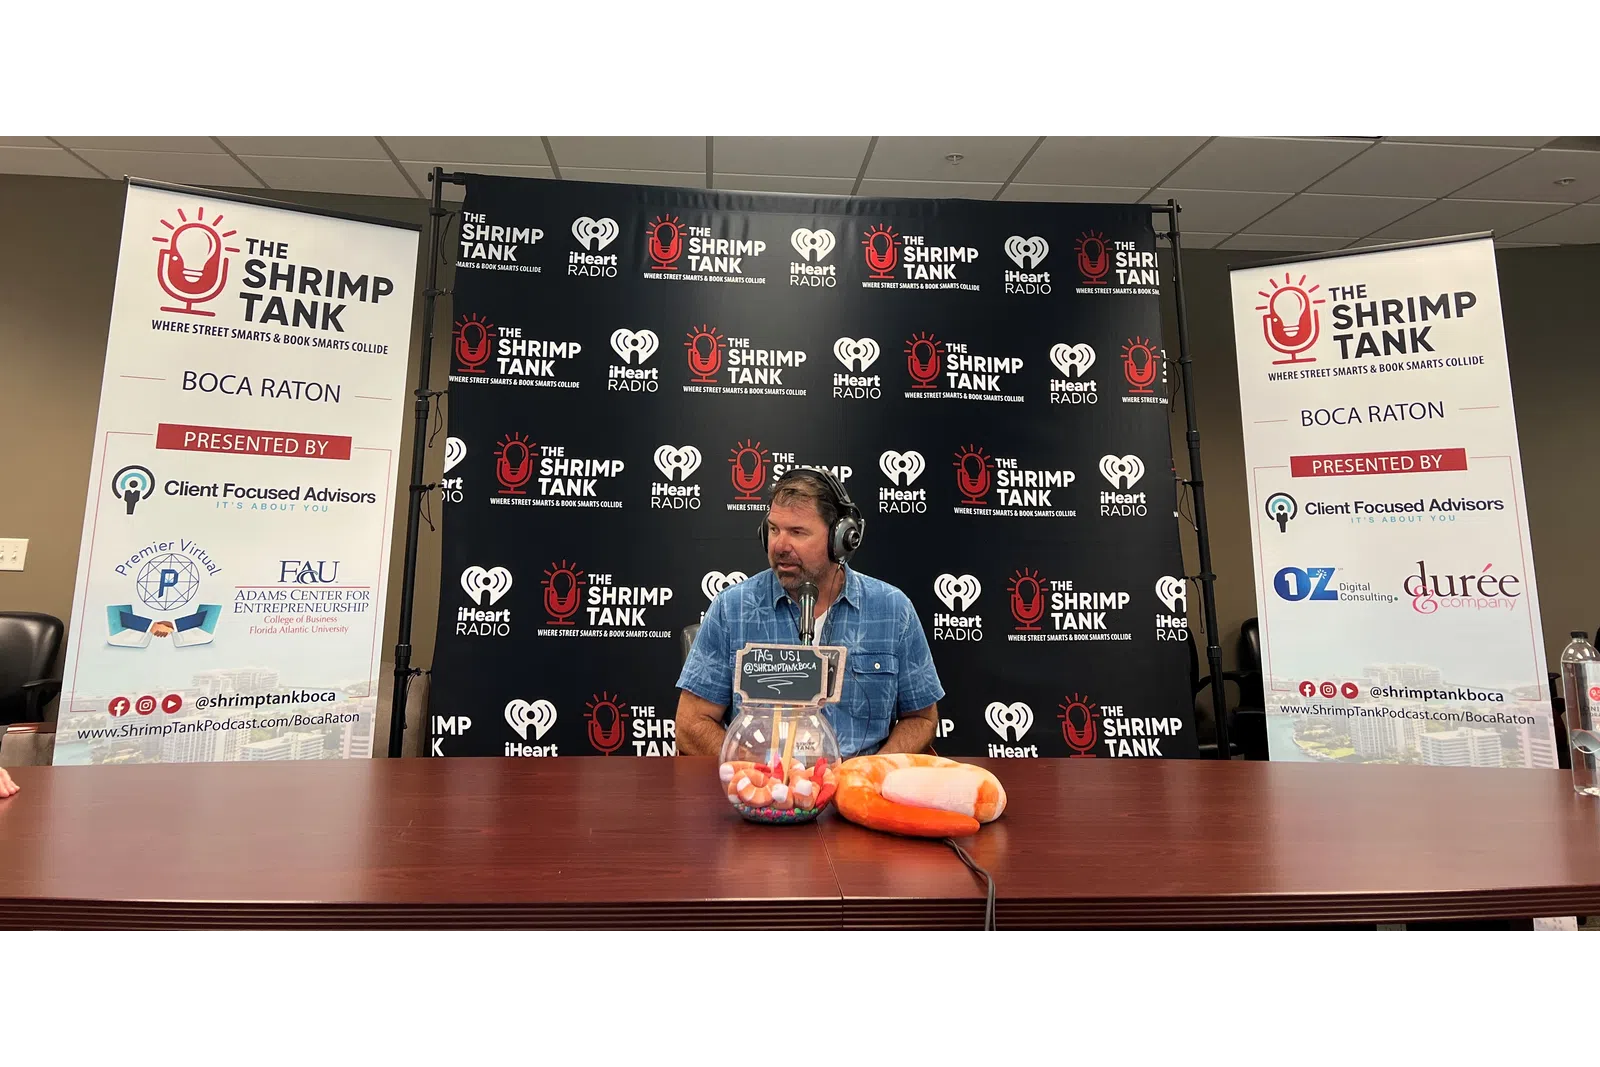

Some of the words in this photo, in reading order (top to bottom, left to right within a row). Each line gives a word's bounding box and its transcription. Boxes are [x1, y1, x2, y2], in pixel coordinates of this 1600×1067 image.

[463, 212, 486, 223] THE
[461, 224, 544, 245] SHRIMP
[689, 226, 711, 237] THE
[245, 238, 288, 259] THE
[689, 237, 766, 256] SHRIMP
[902, 236, 924, 246] THE
[460, 241, 517, 261] TANK
[569, 251, 617, 266] iHeart
[903, 246, 979, 263] SHRIMP
[567, 264, 618, 278] RADIO
[688, 255, 742, 274] TANK
[790, 262, 836, 276] iHeart
[903, 263, 957, 280] TANK
[242, 259, 394, 304] SHRIMP
[790, 274, 836, 288] RADIO
[1005, 270, 1050, 283] iHeart
[1005, 282, 1051, 295] RADIO
[1329, 284, 1367, 302] THE
[239, 292, 347, 332] TANK
[1332, 291, 1477, 330] SHRIMP
[152, 319, 190, 333] WHERE
[192, 324, 229, 339] STREET
[231, 328, 271, 342] SMARTS
[274, 333, 281, 343] &
[283, 333, 310, 347] BOOK
[312, 336, 349, 351] SMARTS
[352, 341, 388, 355] COLLIDE
[498, 327, 522, 338] THE
[498, 338, 582, 359] SHRIMP
[728, 338, 749, 348] THE
[946, 343, 968, 354] THE
[1333, 326, 1435, 360] TANK
[497, 358, 556, 377] TANK
[728, 350, 807, 368] SHRIMP
[947, 354, 1024, 375] SHRIMP
[609, 365, 658, 380] iHeart
[727, 367, 782, 385] TANK
[1268, 370, 1298, 382] WHERE
[1300, 368, 1331, 379] STREET
[1333, 365, 1368, 377] SMARTS
[1370, 365, 1377, 374] &
[1379, 362, 1405, 373] BOOK
[1406, 359, 1444, 370] SMARTS
[1446, 355, 1484, 367] COLLIDE
[182, 371, 252, 396] BOCA
[260, 377, 341, 403] RATON
[608, 379, 658, 393] RADIO
[834, 373, 880, 387] iHeart
[947, 372, 1001, 392] TANK
[1050, 379, 1097, 392] iHeart
[833, 386, 881, 400] RADIO
[1050, 391, 1098, 404] RADIO
[1301, 408, 1362, 427] BOCA
[1368, 401, 1444, 423] RATON
[184, 431, 299, 454] PRESENTED
[305, 438, 329, 456] BY
[541, 446, 564, 457] THE
[540, 459, 624, 478] SHRIMP
[995, 458, 1017, 468] THE
[1312, 456, 1414, 474] PRESENTED
[1420, 455, 1443, 469] BY
[538, 477, 597, 497] TANK
[996, 470, 1075, 488] SHRIMP
[164, 479, 219, 498] Client
[223, 483, 300, 502] Focused
[303, 487, 376, 504] Advisors
[652, 482, 700, 497] iHeart
[879, 488, 926, 501] iHeart
[996, 489, 1052, 506] TANK
[1100, 492, 1146, 504] iHeart
[216, 501, 244, 509] IT'S
[251, 502, 296, 511] ABOUT
[303, 504, 329, 512] YOU
[651, 496, 700, 510] RADIO
[879, 501, 926, 513] RADIO
[1100, 504, 1147, 517] RADIO
[1305, 501, 1350, 515] Client
[1354, 500, 1424, 514] Focused
[1428, 498, 1504, 512] Advisors
[115, 540, 174, 577] Premier
[180, 538, 222, 577] Virtual
[278, 560, 340, 584] FAU
[588, 574, 612, 585] THE
[1403, 560, 1521, 598] durée
[1051, 580, 1072, 591] THE
[1339, 582, 1370, 593] Digital
[234, 590, 288, 600] ADAMS
[291, 589, 342, 600] CENTER
[346, 590, 370, 600] FOR
[588, 586, 673, 606] SHRIMP
[1051, 592, 1130, 610] SHRIMP
[1412, 585, 1438, 614] &
[1440, 596, 1517, 611] company
[233, 602, 370, 613] ENTREPRENEURSHIP
[458, 607, 510, 622] iHeart
[263, 615, 294, 626] College
[296, 615, 303, 624] of
[305, 614, 338, 624] Business
[587, 608, 646, 626] TANK
[934, 613, 982, 628] iHeart
[1051, 613, 1107, 630] TANK
[249, 625, 277, 634] Florida
[278, 625, 308, 634] Atlantic
[311, 625, 349, 636] University
[456, 623, 510, 636] RADIO
[934, 628, 982, 641] RADIO
[751, 649, 773, 661] TAG
[195, 690, 336, 710] @shrimptankboca
[1369, 686, 1504, 703] @shrimptankboca
[1101, 706, 1123, 717] THE
[1280, 704, 1535, 725] www.ShrimpTankPodcast.com/BocaRaton
[78, 712, 360, 739] www.ShrimpTankPodcast.com/BocaRaton
[1103, 717, 1182, 736] SHRIMP
[505, 742, 558, 757] iHeart
[988, 744, 1038, 758] iHeart
[1105, 738, 1162, 757] TANK
